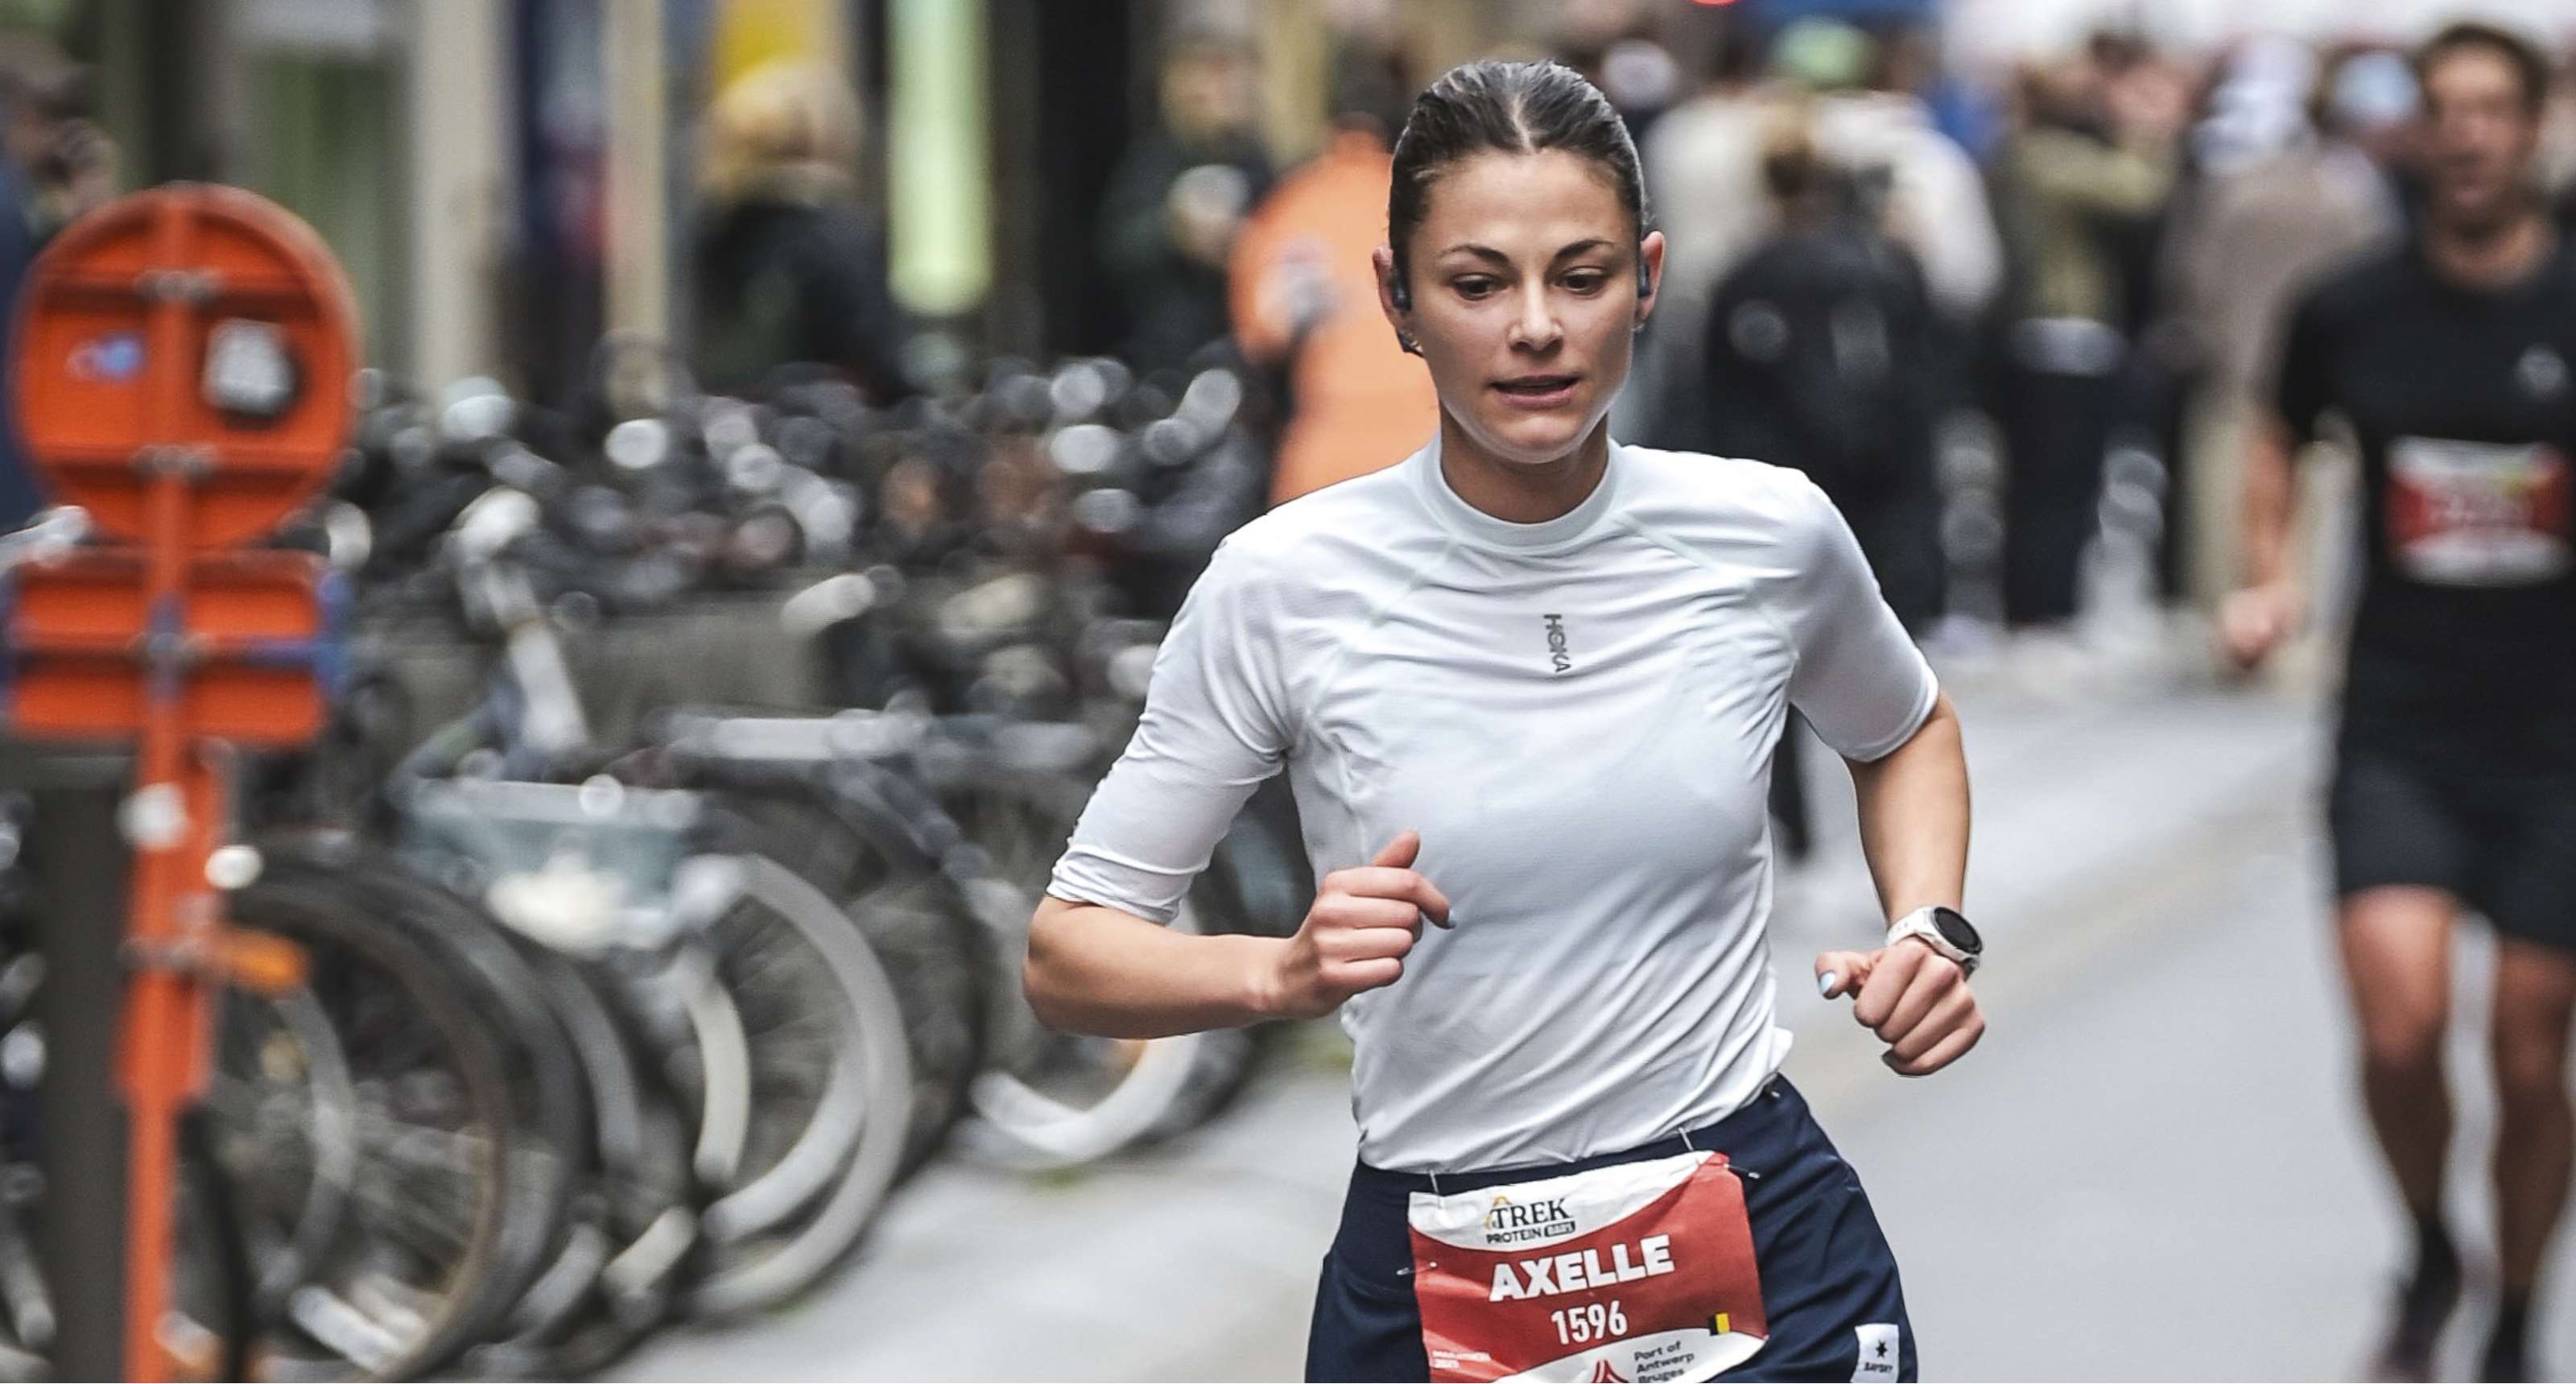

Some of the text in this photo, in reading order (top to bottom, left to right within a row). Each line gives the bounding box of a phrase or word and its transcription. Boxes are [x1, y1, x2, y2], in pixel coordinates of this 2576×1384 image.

[1544, 614, 1571, 672] HOKA
[1489, 1198, 1571, 1229] TREK
[1485, 1227, 1542, 1245] PROTEIN
[1489, 1234, 1675, 1302] AXELLE
[1551, 1300, 1628, 1345] 1596
[1634, 1341, 1681, 1361] Port of
[1637, 1353, 1695, 1373] Antwerp
[1638, 1369, 1684, 1383] Bruges
